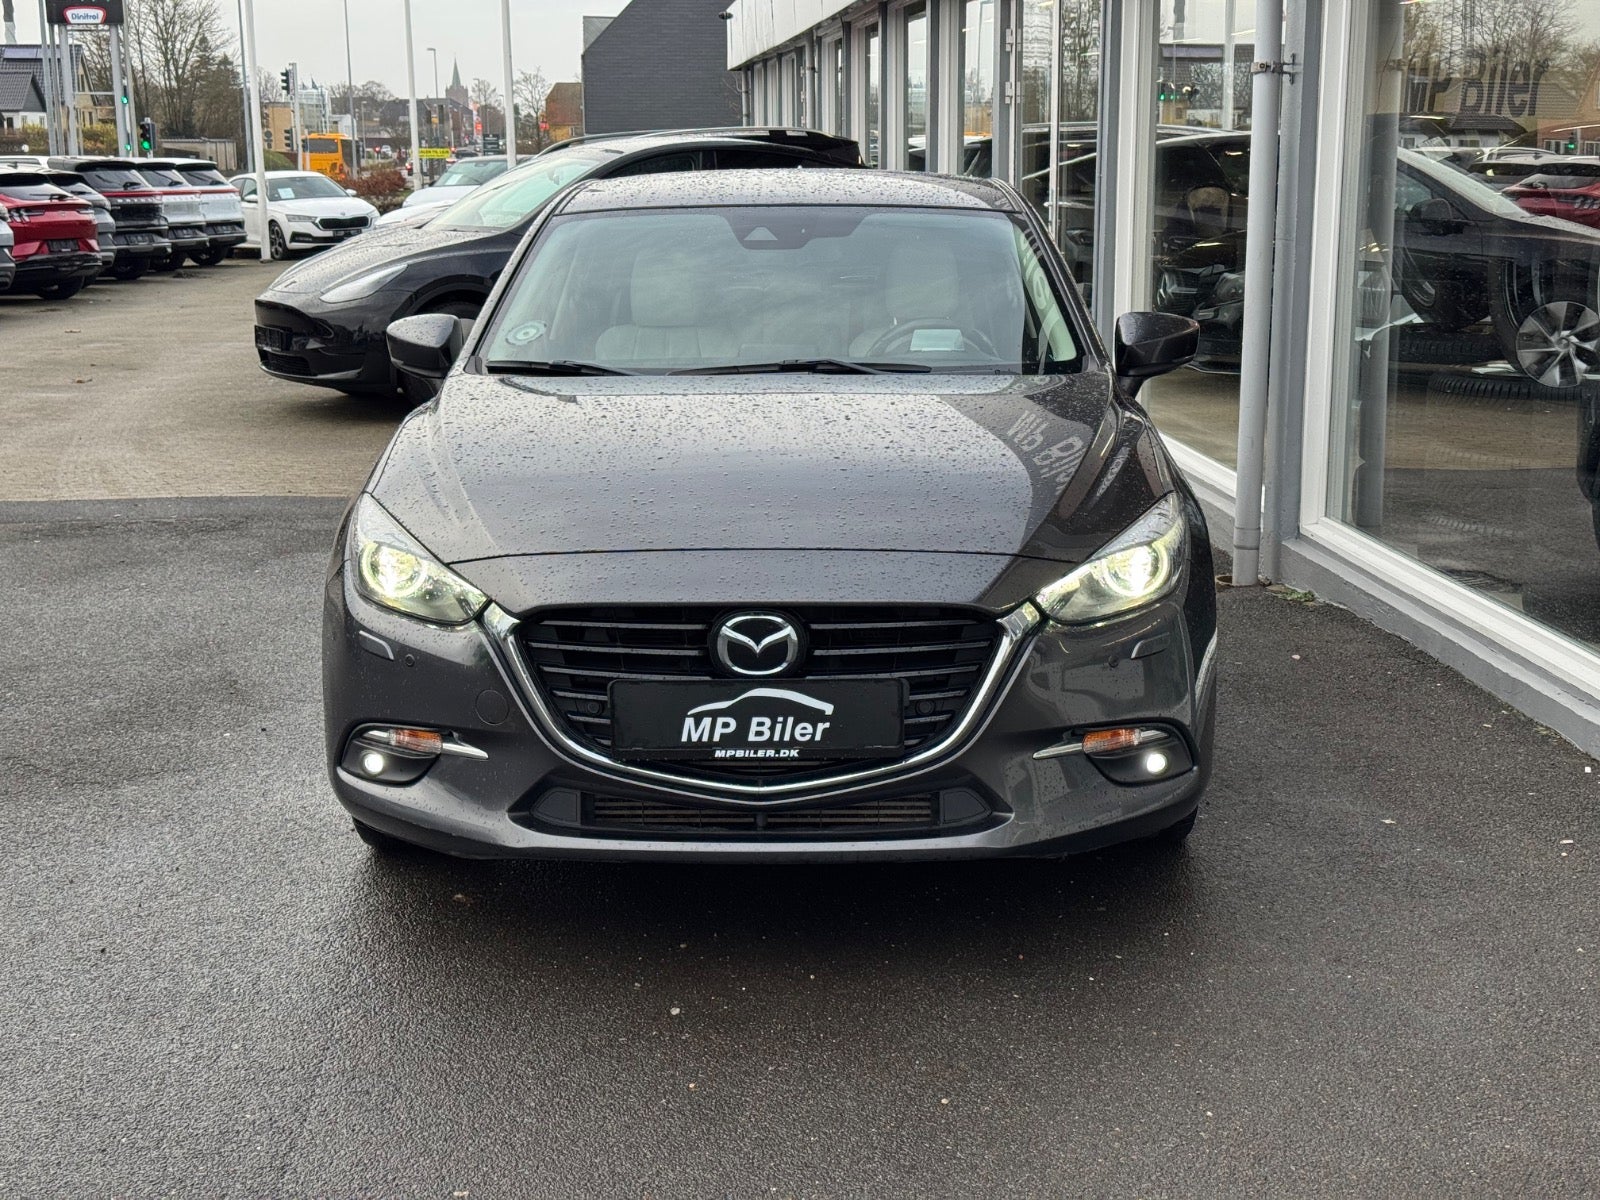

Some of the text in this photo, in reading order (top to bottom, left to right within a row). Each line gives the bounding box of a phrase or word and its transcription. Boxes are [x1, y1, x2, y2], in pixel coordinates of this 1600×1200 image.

[71, 12, 99, 20] Dinitrol
[1459, 49, 1549, 117] Biler
[681, 716, 831, 743] MP Biler
[714, 749, 799, 758] MPBILER.DK
